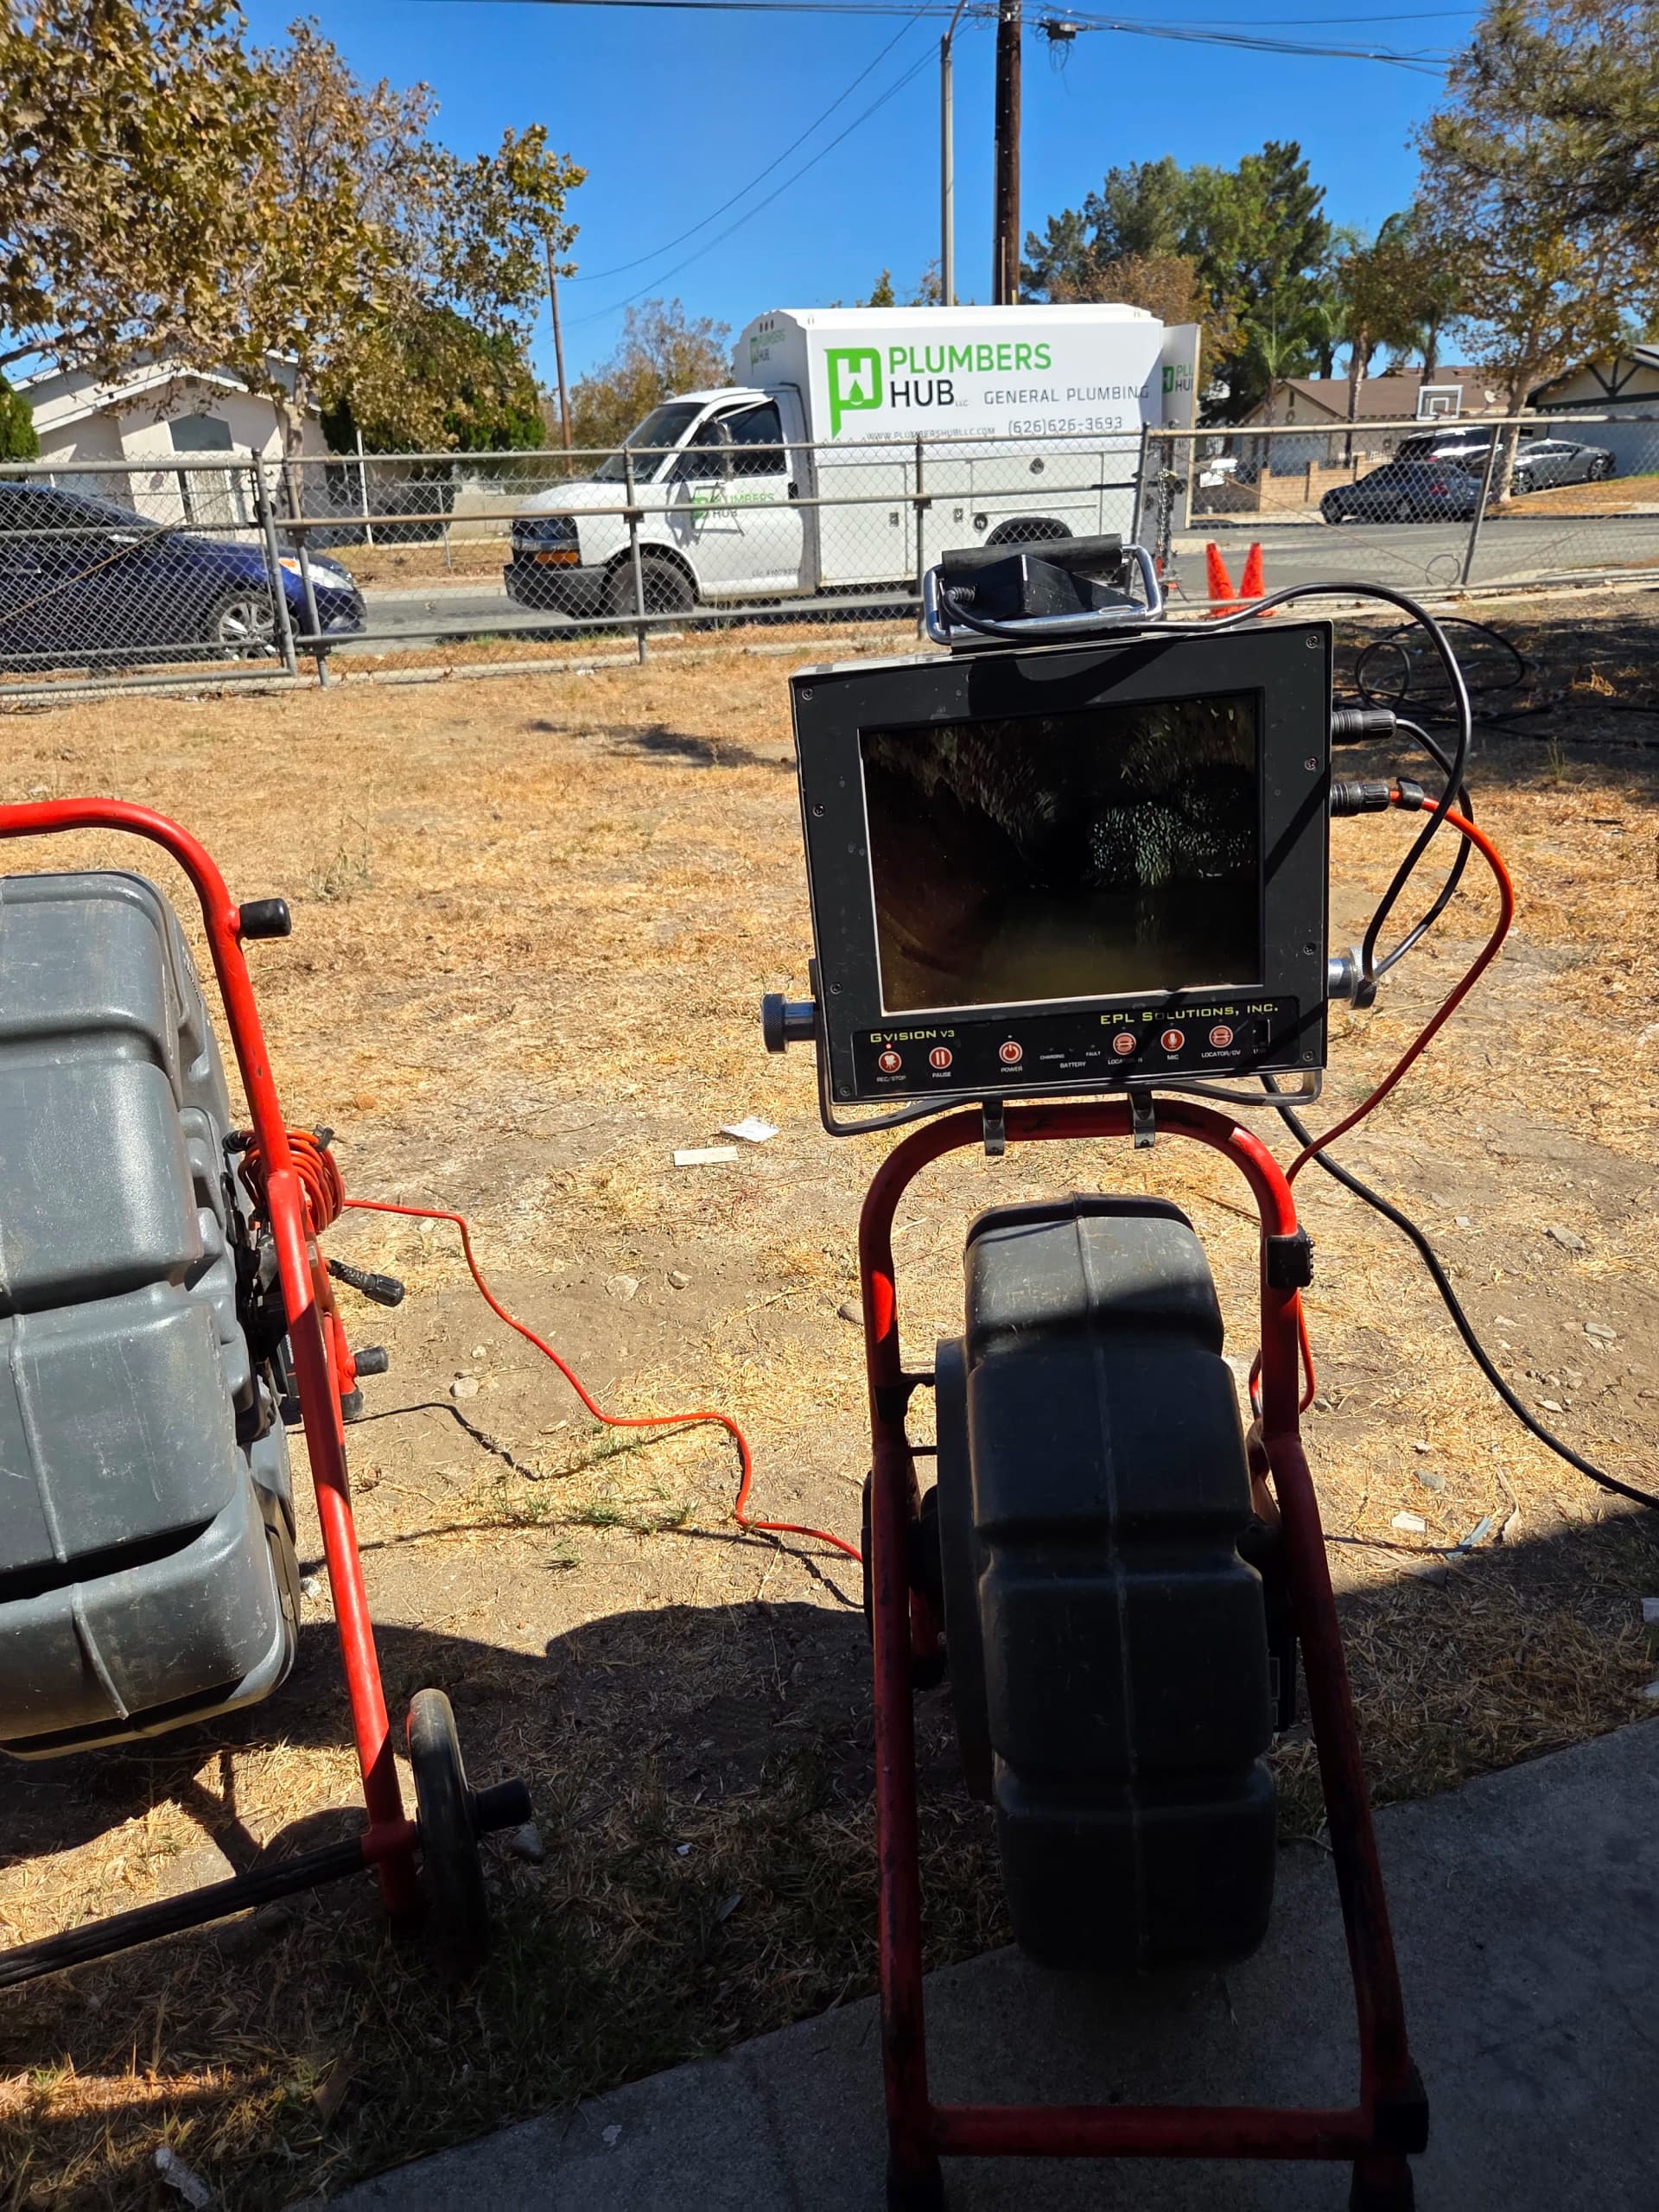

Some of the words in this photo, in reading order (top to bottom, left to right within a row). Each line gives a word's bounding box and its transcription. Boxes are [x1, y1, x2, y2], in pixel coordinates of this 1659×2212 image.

[889, 343, 1052, 374] PLUMBERS
[890, 378, 955, 408] HUB
[954, 399, 969, 408] LLC
[983, 389, 1059, 405] GENERAL
[1066, 385, 1149, 402] PLUMBING
[1174, 378, 1194, 393] HU
[1007, 416, 1123, 436] (626)626-3693
[1100, 1014, 1135, 1026] EPL
[1141, 1006, 1240, 1022] SOLUTIONS,
[1247, 1003, 1279, 1014] INC.
[870, 1030, 937, 1043] GVISION
[940, 1030, 955, 1039] V3
[1059, 1060, 1087, 1069] BATTERY
[876, 1075, 907, 1084] REC/STOP
